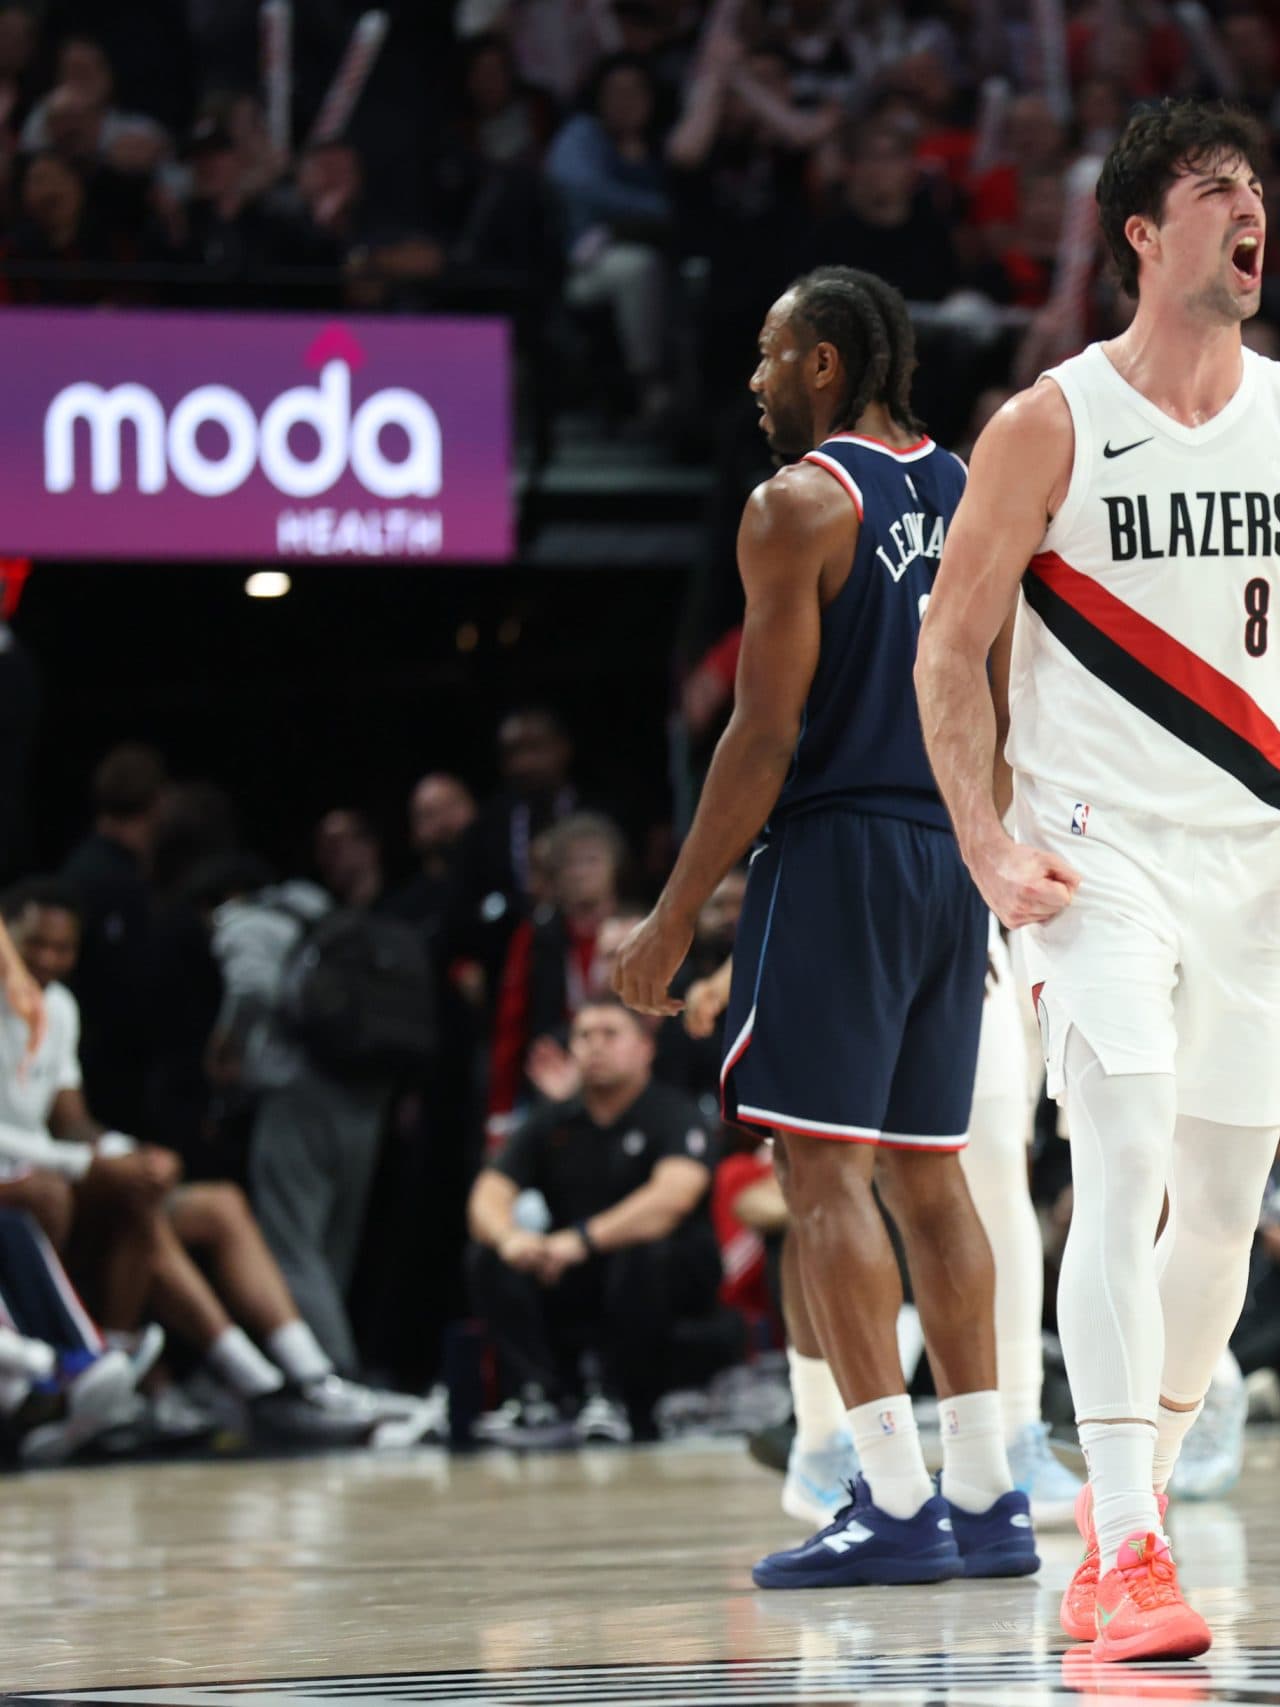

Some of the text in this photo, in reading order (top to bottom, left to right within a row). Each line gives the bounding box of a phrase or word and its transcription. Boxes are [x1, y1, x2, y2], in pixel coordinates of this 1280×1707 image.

[44, 358, 442, 498] moda
[276, 507, 443, 556] HEALTH
[875, 512, 944, 582] LEONA
[1244, 577, 1270, 657] 8
